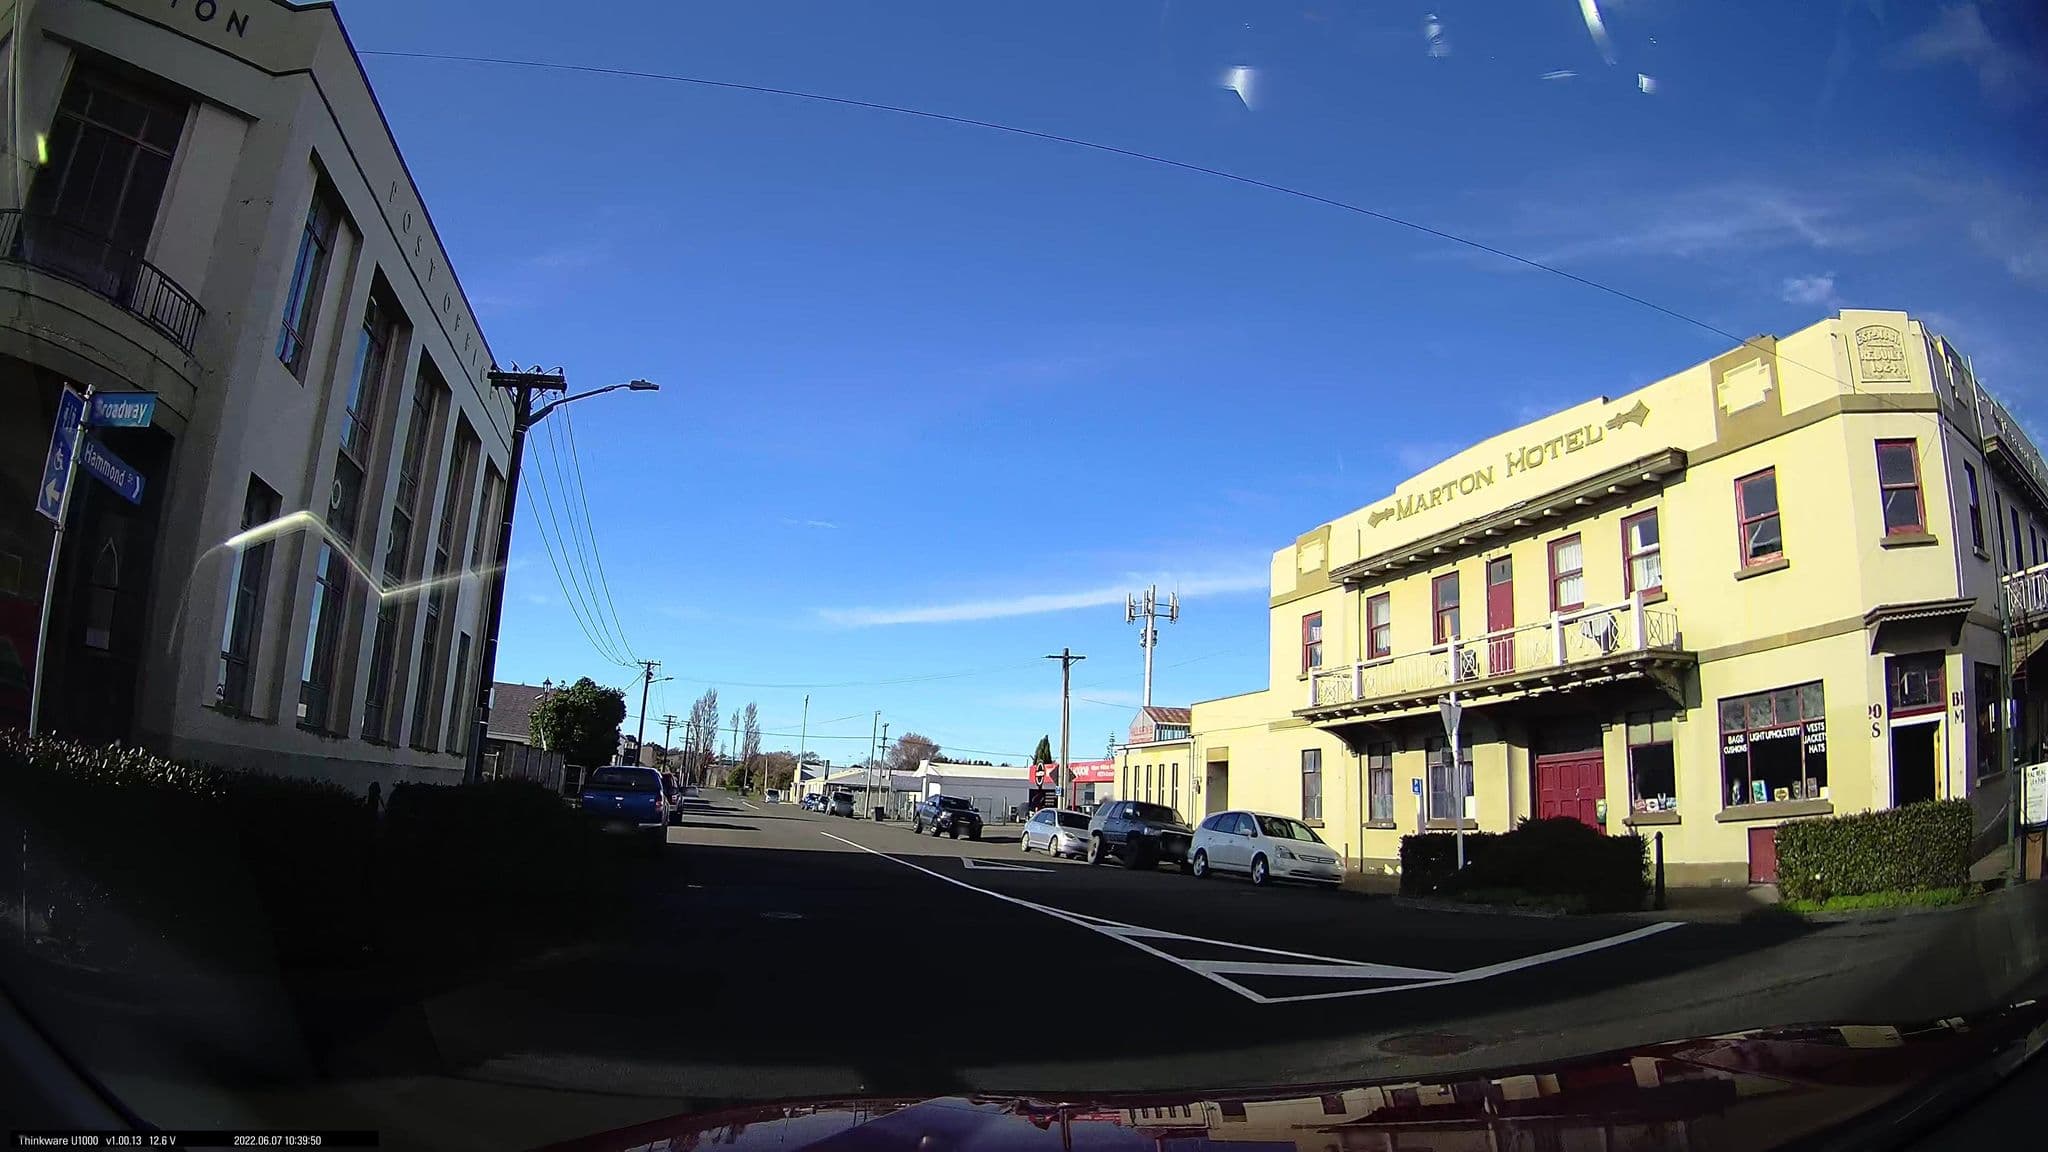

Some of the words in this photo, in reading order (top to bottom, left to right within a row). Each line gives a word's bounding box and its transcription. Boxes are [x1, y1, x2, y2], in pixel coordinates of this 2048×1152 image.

[170, 0, 250, 38] ON
[96, 400, 149, 424] Broadway
[84, 440, 126, 489] Hammond
[1396, 465, 1494, 521] MARTON
[1505, 423, 1604, 478] HOTEL
[1749, 731, 1765, 742] LIGHT
[1765, 726, 1801, 740] UPHOLSTERY
[1806, 722, 1825, 733] VESTS
[1727, 734, 1744, 745] BAGS
[1808, 743, 1826, 754] HATS
